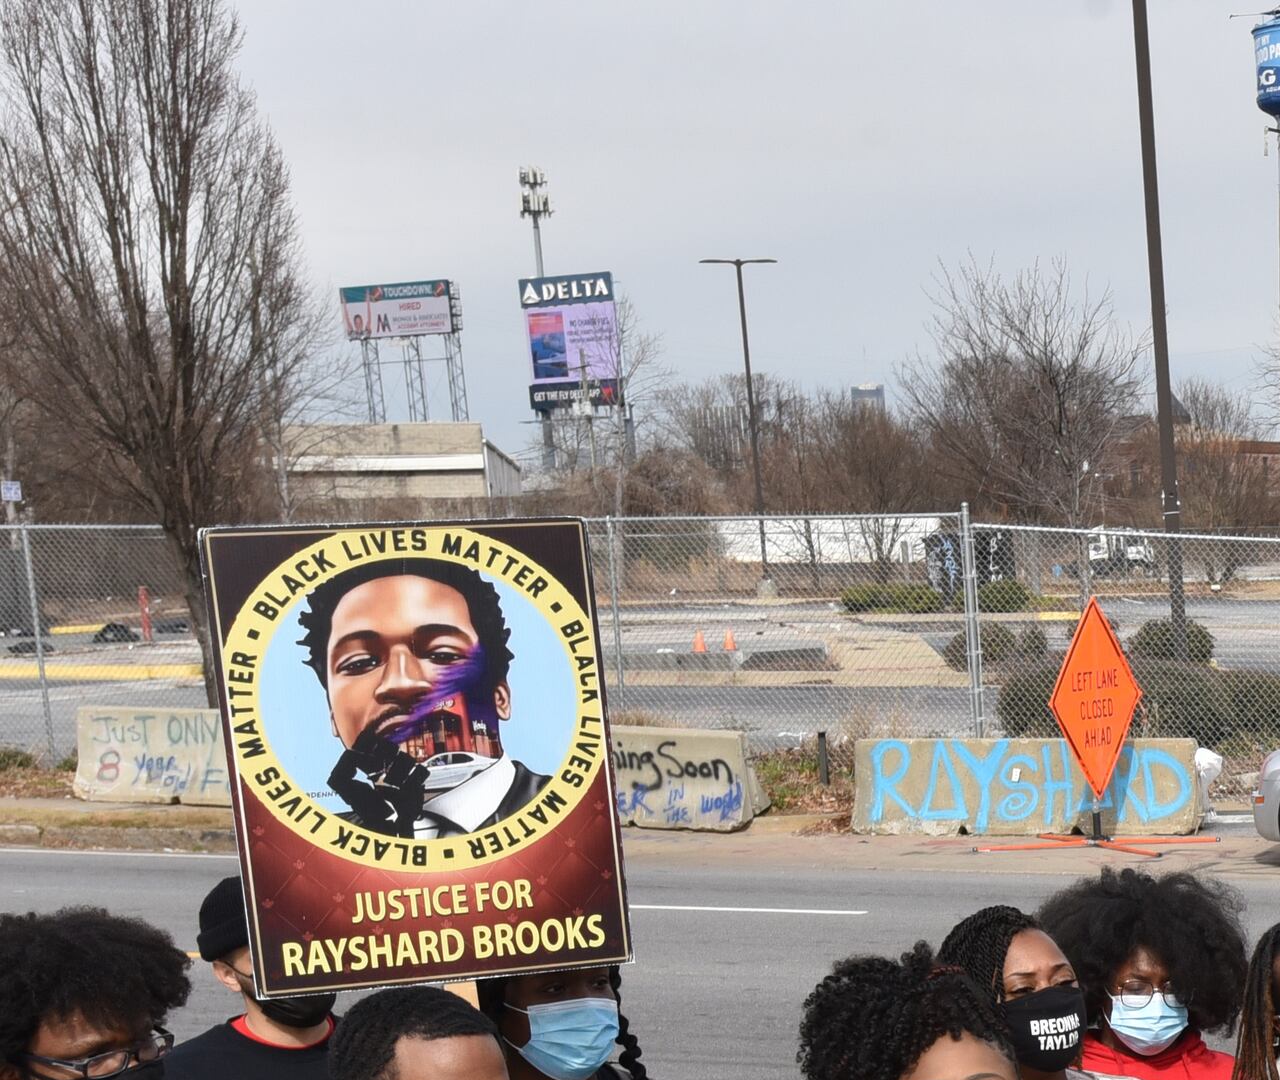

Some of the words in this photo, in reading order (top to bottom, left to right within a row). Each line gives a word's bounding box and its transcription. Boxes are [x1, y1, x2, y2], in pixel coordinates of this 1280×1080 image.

[399, 302, 421, 311] HIRED
[542, 278, 608, 301] DELTA
[534, 392, 545, 401] GET
[546, 391, 558, 400] THE
[559, 391, 569, 399] FLY
[253, 548, 338, 620] BLACK
[341, 530, 428, 561] LIVES
[440, 533, 550, 598] MATTER
[560, 620, 599, 705] BLACK
[1072, 672, 1093, 692] LEFT
[1096, 669, 1118, 689] LANE
[231, 651, 266, 759] MATTER
[1080, 698, 1113, 720] CLOSED
[96, 750, 121, 782] 8
[562, 715, 602, 788] LIVES
[658, 742, 734, 784] Soon
[254, 766, 326, 834] LIVES
[330, 826, 428, 867] BLACK
[467, 794, 568, 860] MATTER
[352, 884, 468, 924] JUSTICE
[474, 878, 534, 914] FOR
[282, 926, 466, 977] RAYSHARD
[472, 915, 606, 960] BROOKS
[1030, 1013, 1080, 1035] BREONNA
[1038, 1031, 1079, 1050] TAYLOR
